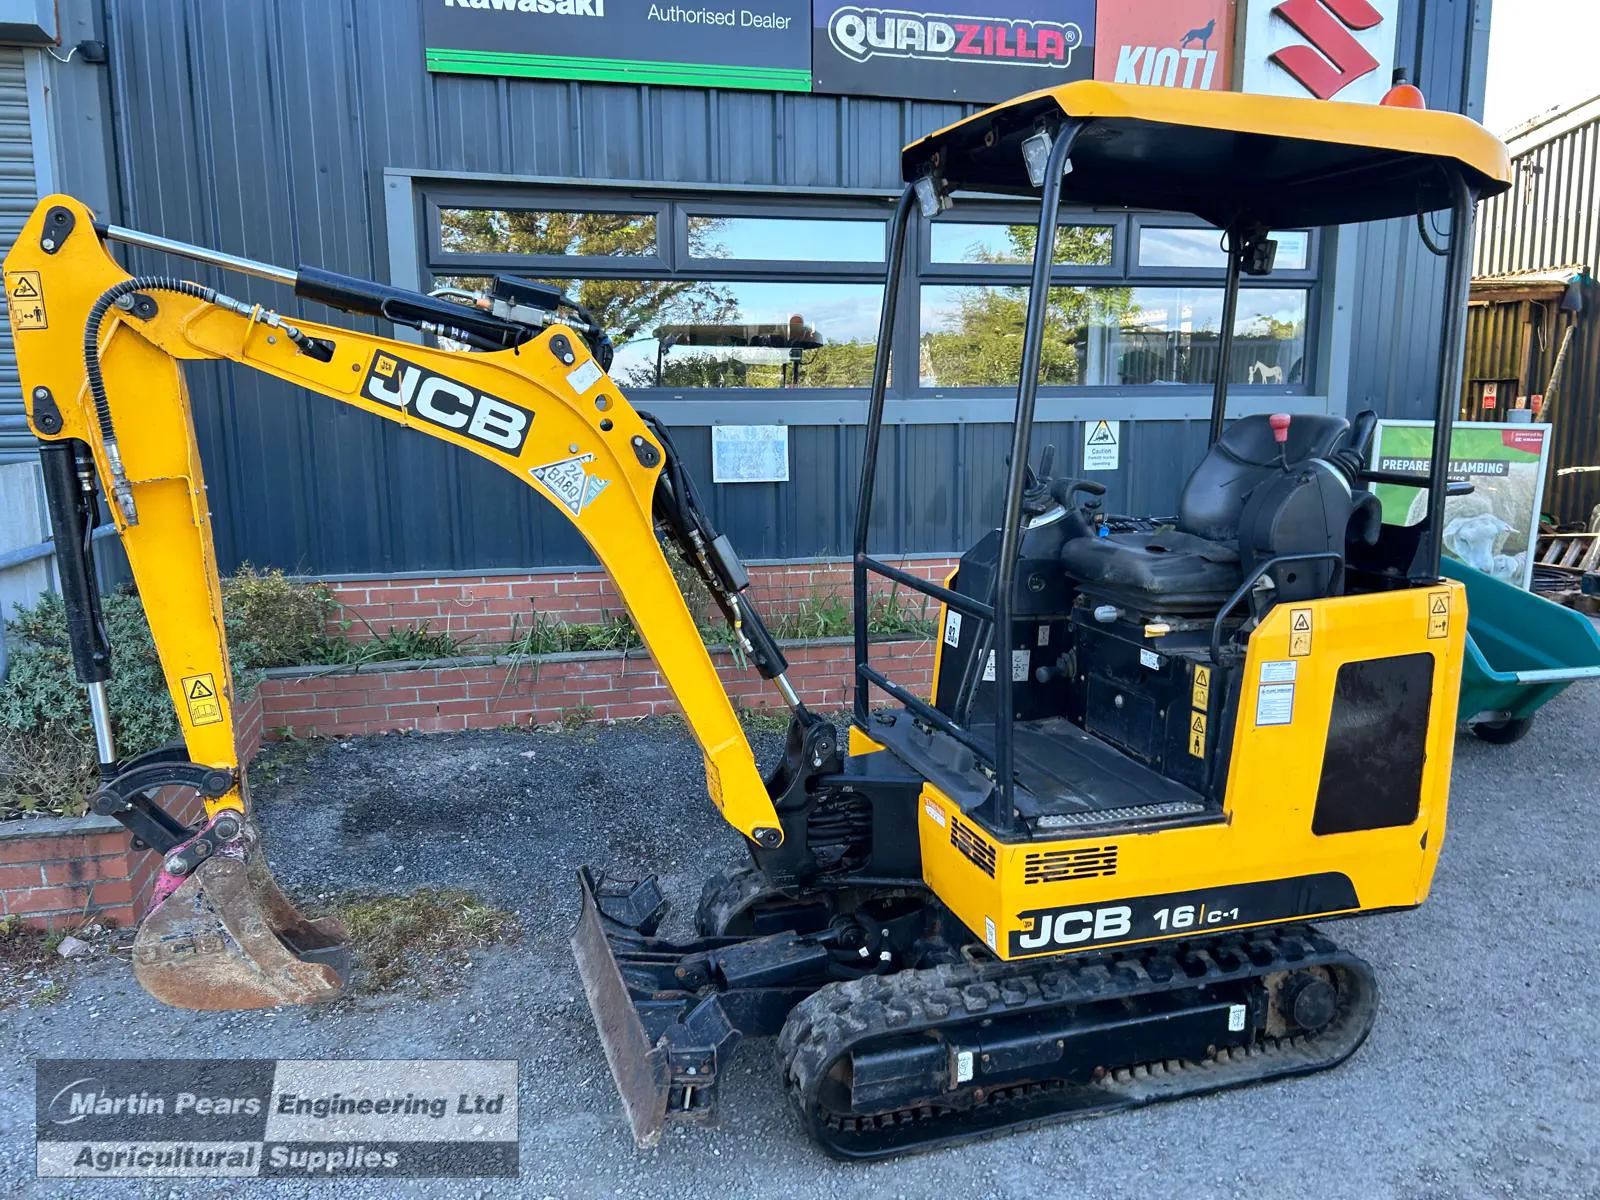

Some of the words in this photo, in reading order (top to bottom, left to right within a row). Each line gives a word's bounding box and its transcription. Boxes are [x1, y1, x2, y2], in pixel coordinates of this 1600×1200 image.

[648, 3, 735, 26] Authorised
[741, 10, 791, 29] Dealer
[1114, 45, 1218, 90] KIOTI
[368, 365, 527, 450] JCB
[564, 464, 582, 482] 24
[1382, 459, 1430, 471] PREPARE
[1453, 462, 1504, 474] LAMBING
[1019, 905, 1132, 949] JCB
[1153, 905, 1195, 930] 16
